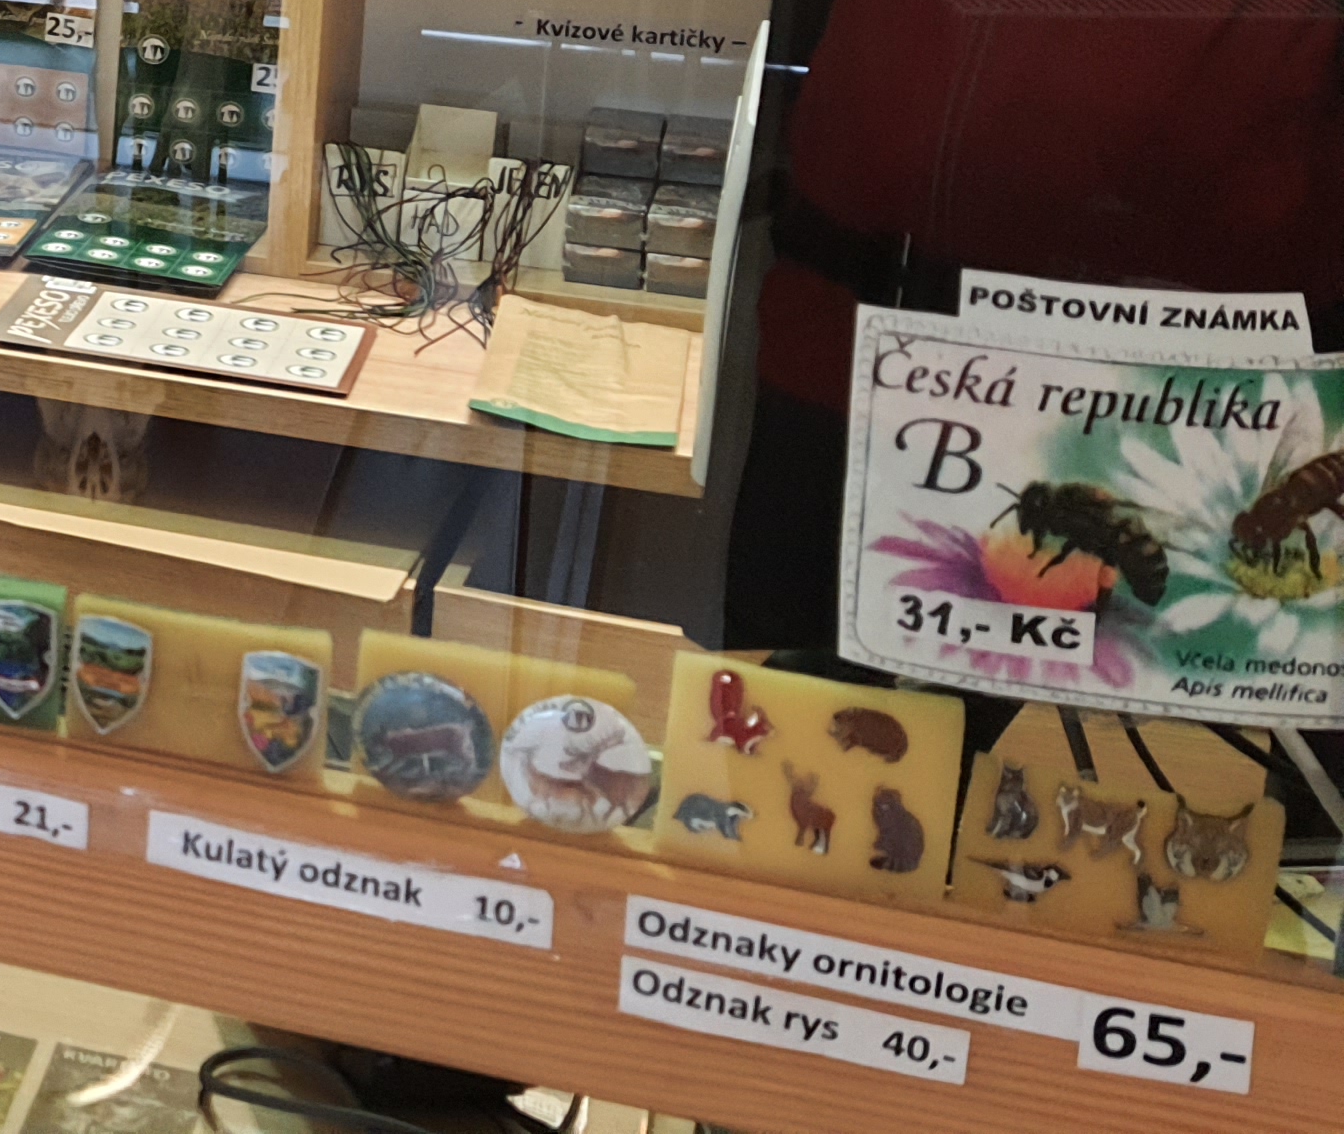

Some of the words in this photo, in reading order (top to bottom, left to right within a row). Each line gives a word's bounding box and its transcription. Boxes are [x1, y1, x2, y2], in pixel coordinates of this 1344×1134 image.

[47, 17, 93, 42] 25,-
[536, 18, 624, 43] Kvízové
[631, 24, 725, 53] kartičky
[106, 171, 231, 195] PEXESO
[6, 288, 71, 344] PEXESO
[969, 286, 1148, 326] POŠTOVNÍ
[1160, 304, 1301, 332] ZNÁMKA
[872, 334, 1018, 408] Česká
[1036, 377, 1283, 436] republika
[895, 417, 984, 494] B
[897, 594, 991, 644] 31,-
[1011, 612, 1082, 651] Kč
[1175, 649, 1237, 675] Včela
[1171, 676, 1223, 700] Apis
[1230, 681, 1329, 706] mellifica
[13, 800, 73, 838] 21,-
[181, 830, 289, 881] Kulatý
[299, 863, 424, 907] odznak
[474, 894, 541, 933] 10,-
[631, 969, 771, 1026] Odznak
[783, 1012, 840, 1044] rys
[881, 1028, 957, 1073] 40,-
[637, 909, 802, 971] Odznaky
[812, 950, 1029, 1019] ornitologie
[1091, 1005, 1247, 1084] 65,-
